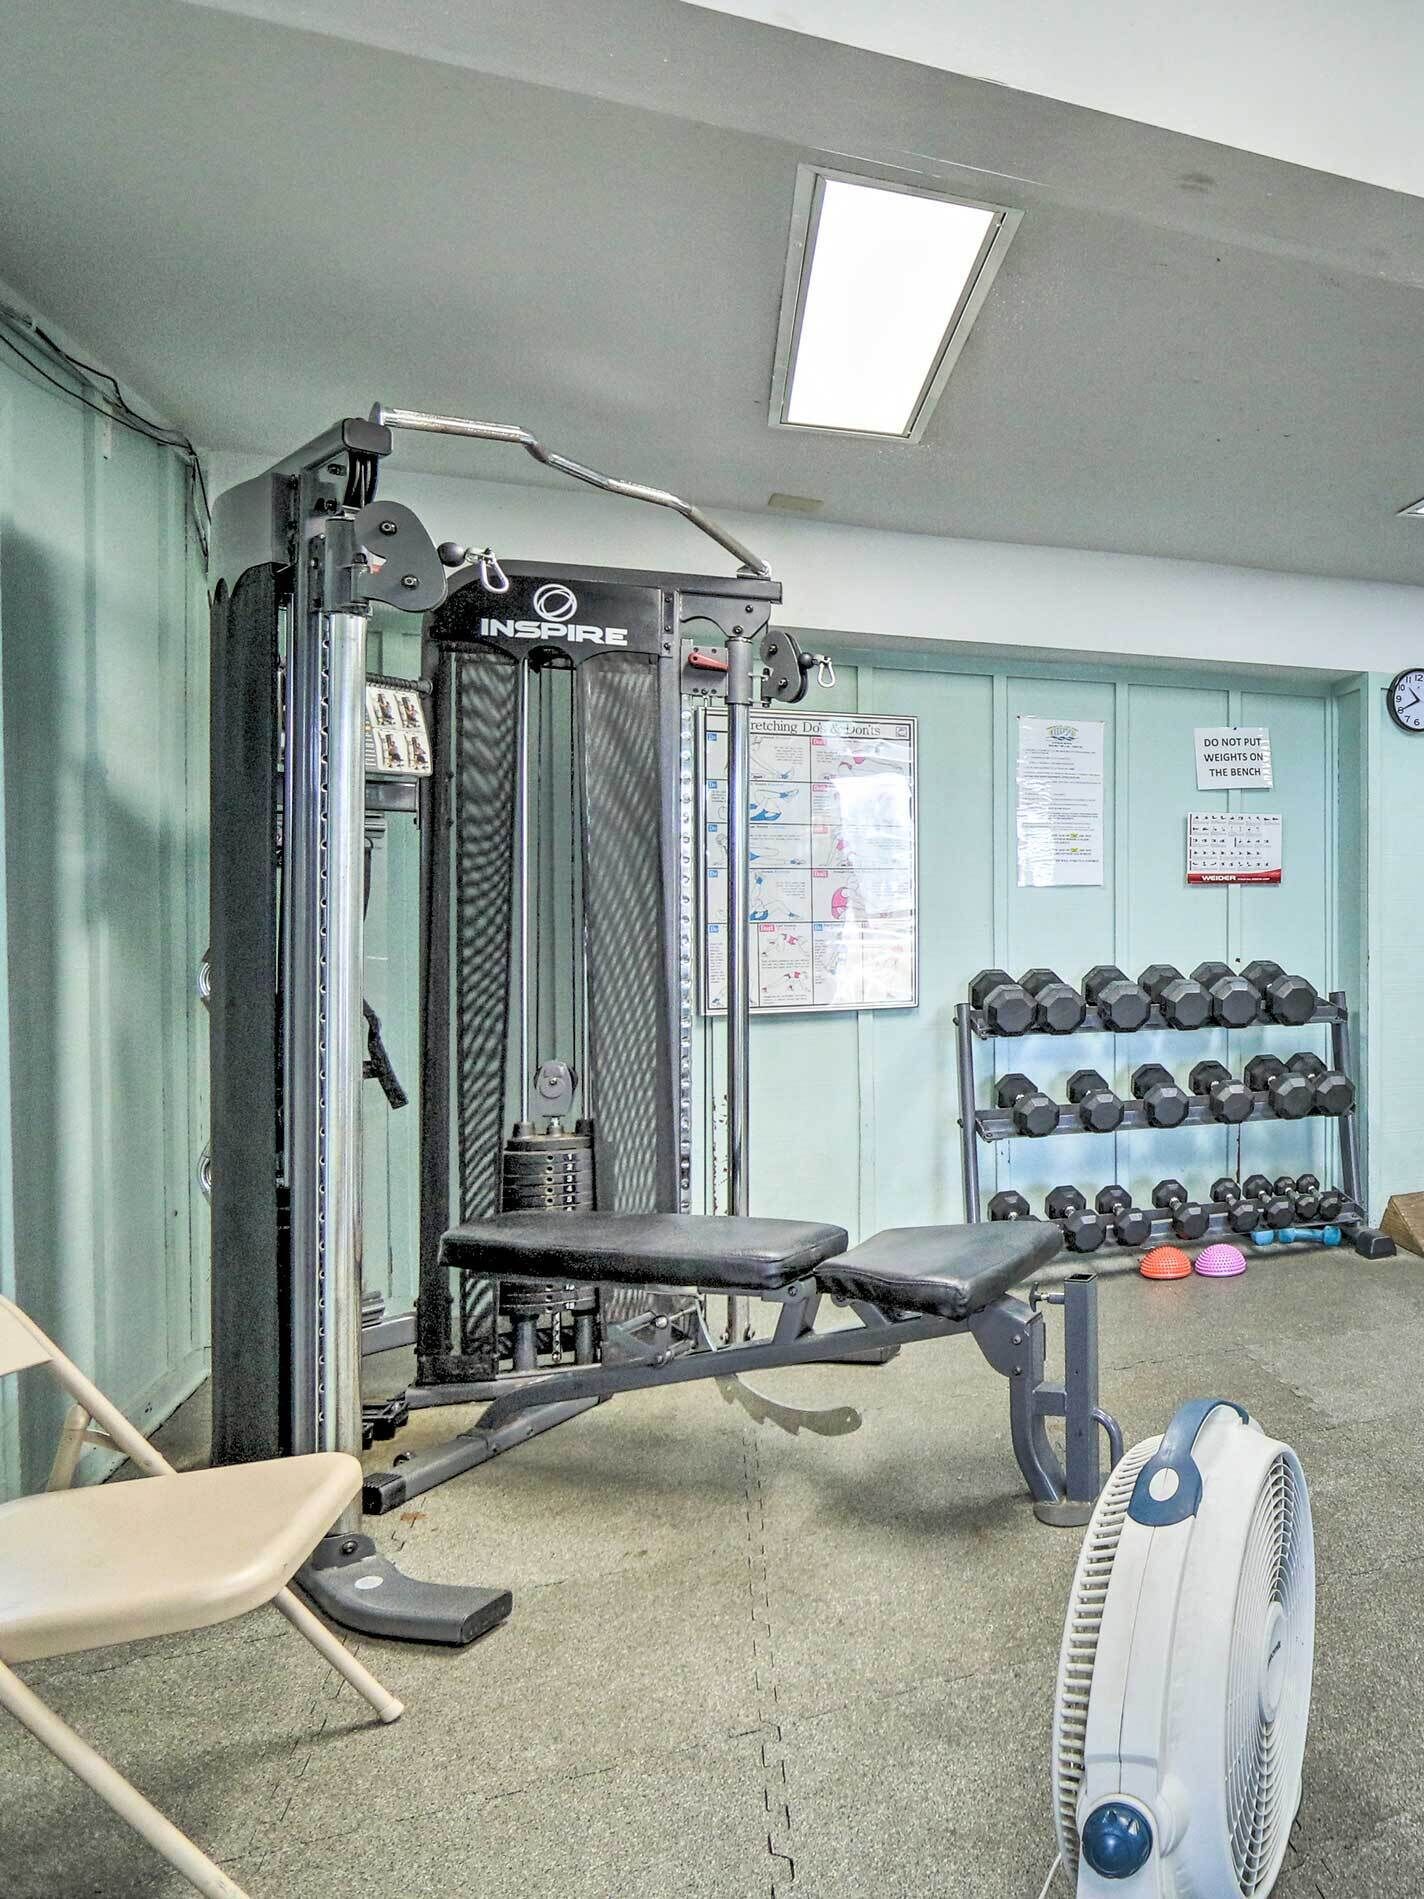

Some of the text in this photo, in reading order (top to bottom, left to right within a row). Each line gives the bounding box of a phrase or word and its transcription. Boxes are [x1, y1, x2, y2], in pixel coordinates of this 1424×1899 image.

[481, 618, 628, 646] INSPIRE
[750, 720, 797, 734] retching
[831, 724, 841, 734] &
[1204, 737, 1262, 747] DO NOT PUT
[1203, 752, 1263, 762] WEIGHTS ON
[1209, 767, 1261, 777] THE BENCH
